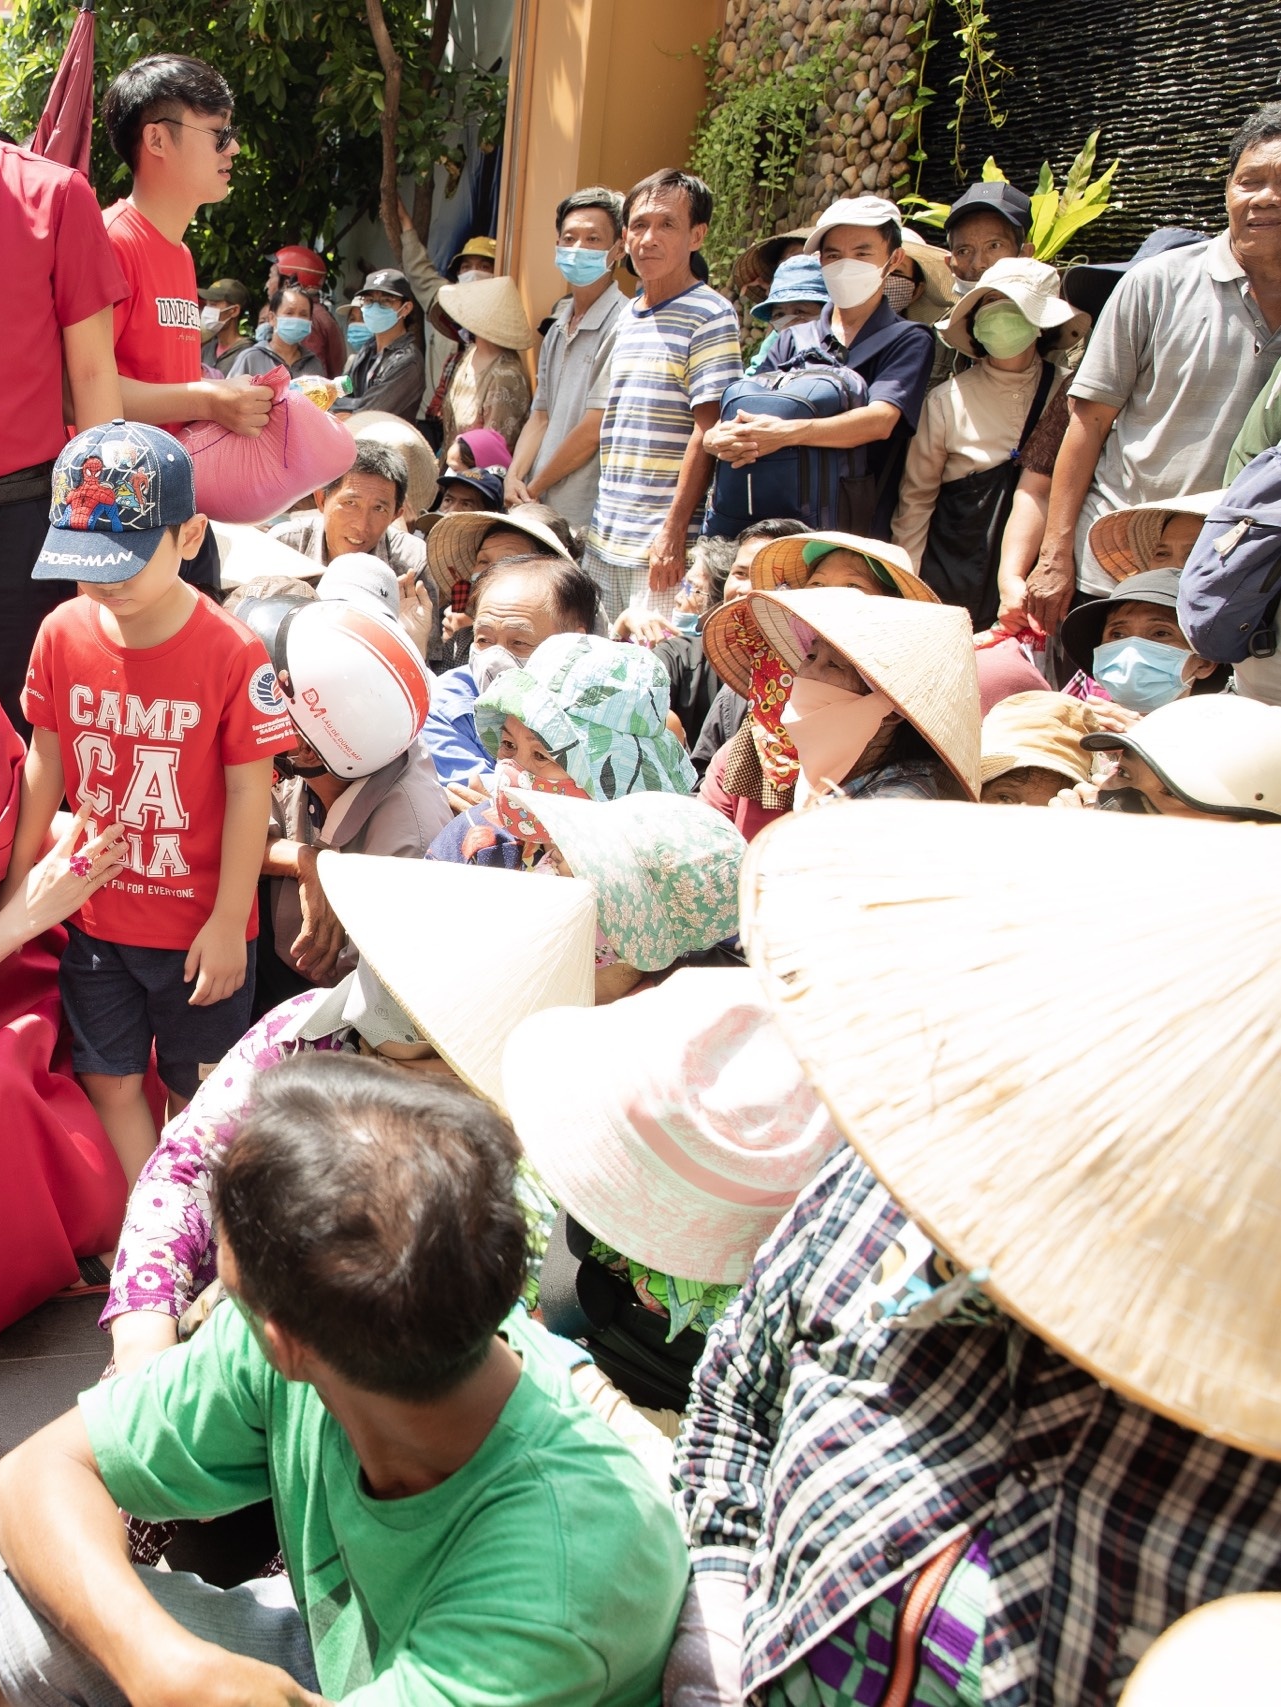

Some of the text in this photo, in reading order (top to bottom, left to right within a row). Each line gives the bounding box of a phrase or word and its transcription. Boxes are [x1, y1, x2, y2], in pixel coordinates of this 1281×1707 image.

[70, 684, 201, 742] CAMP
[73, 731, 189, 831] CA
[127, 883, 144, 894] FOR
[148, 884, 195, 898] EVERYONE
